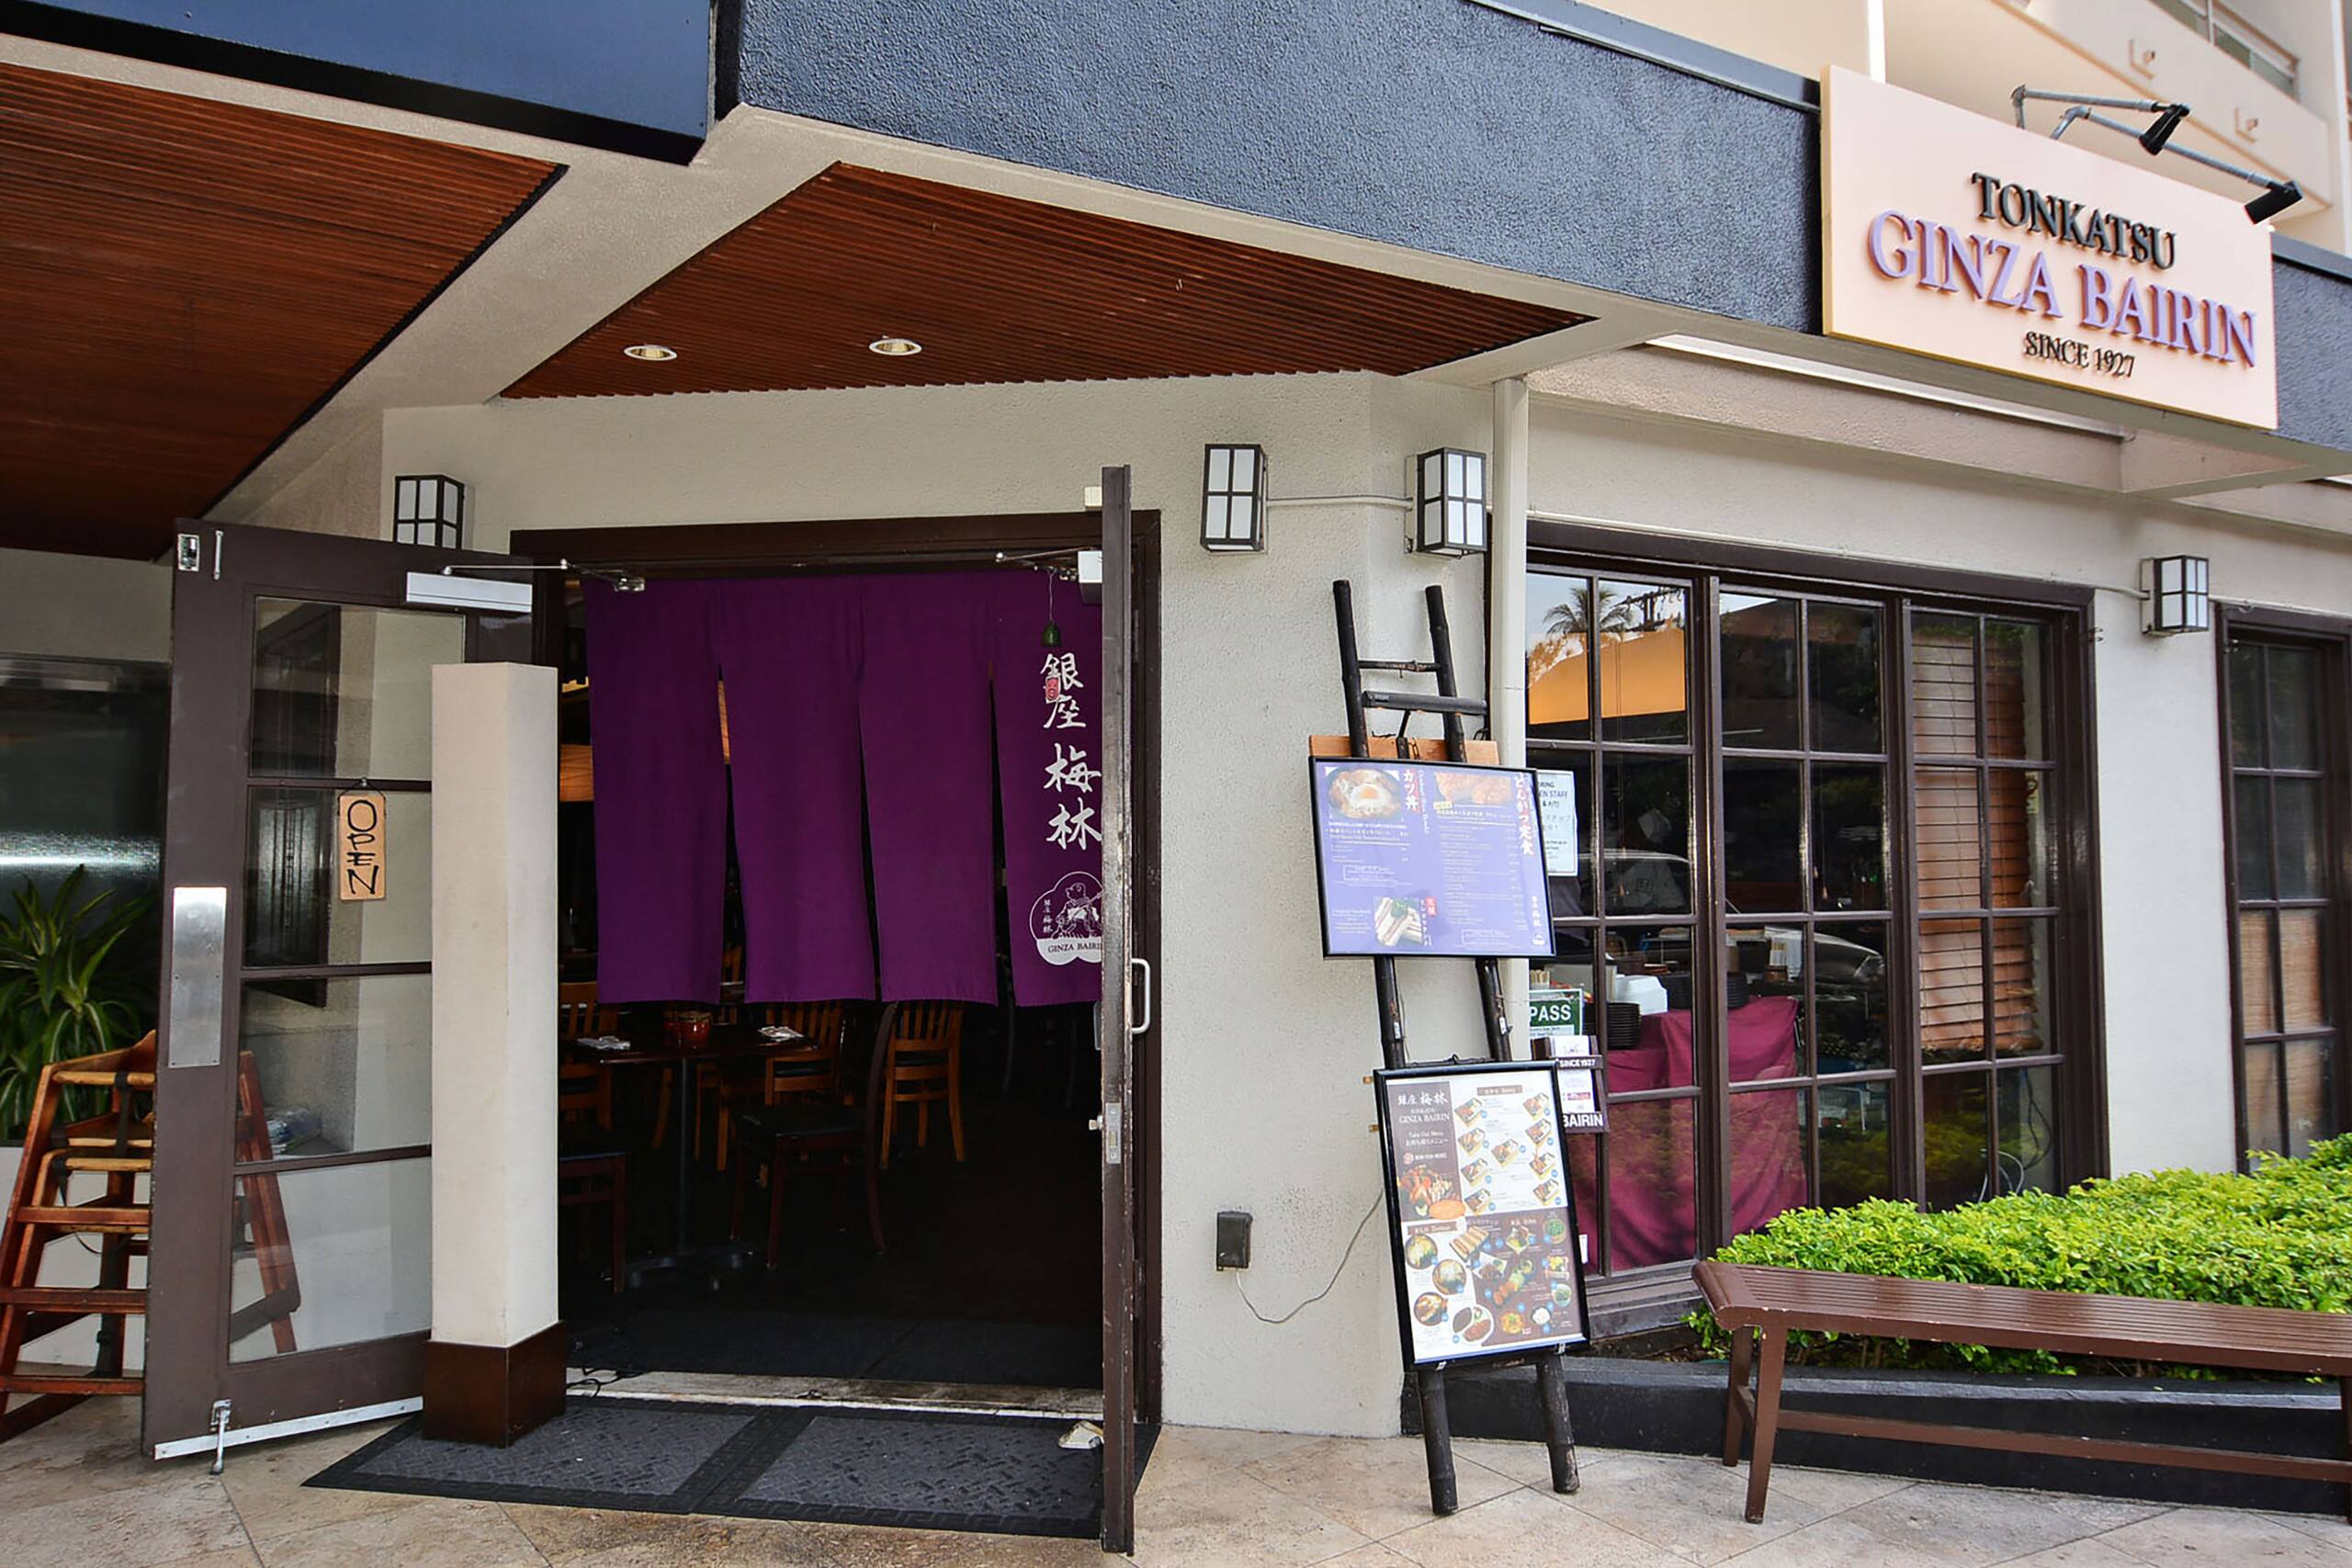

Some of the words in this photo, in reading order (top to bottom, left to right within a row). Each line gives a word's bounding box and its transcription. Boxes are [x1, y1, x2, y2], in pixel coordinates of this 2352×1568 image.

[1971, 172, 2177, 270] TONKATSU
[1868, 209, 2063, 319] GINZA
[2077, 263, 2256, 367] BAIRIN
[2024, 332, 2089, 368] SINCE
[2095, 347, 2135, 378] 1927
[347, 799, 379, 895] OPEN
[1047, 943, 1074, 953] GINZA
[1077, 942, 1102, 951] BAIRI
[1530, 1004, 1572, 1021] PASS
